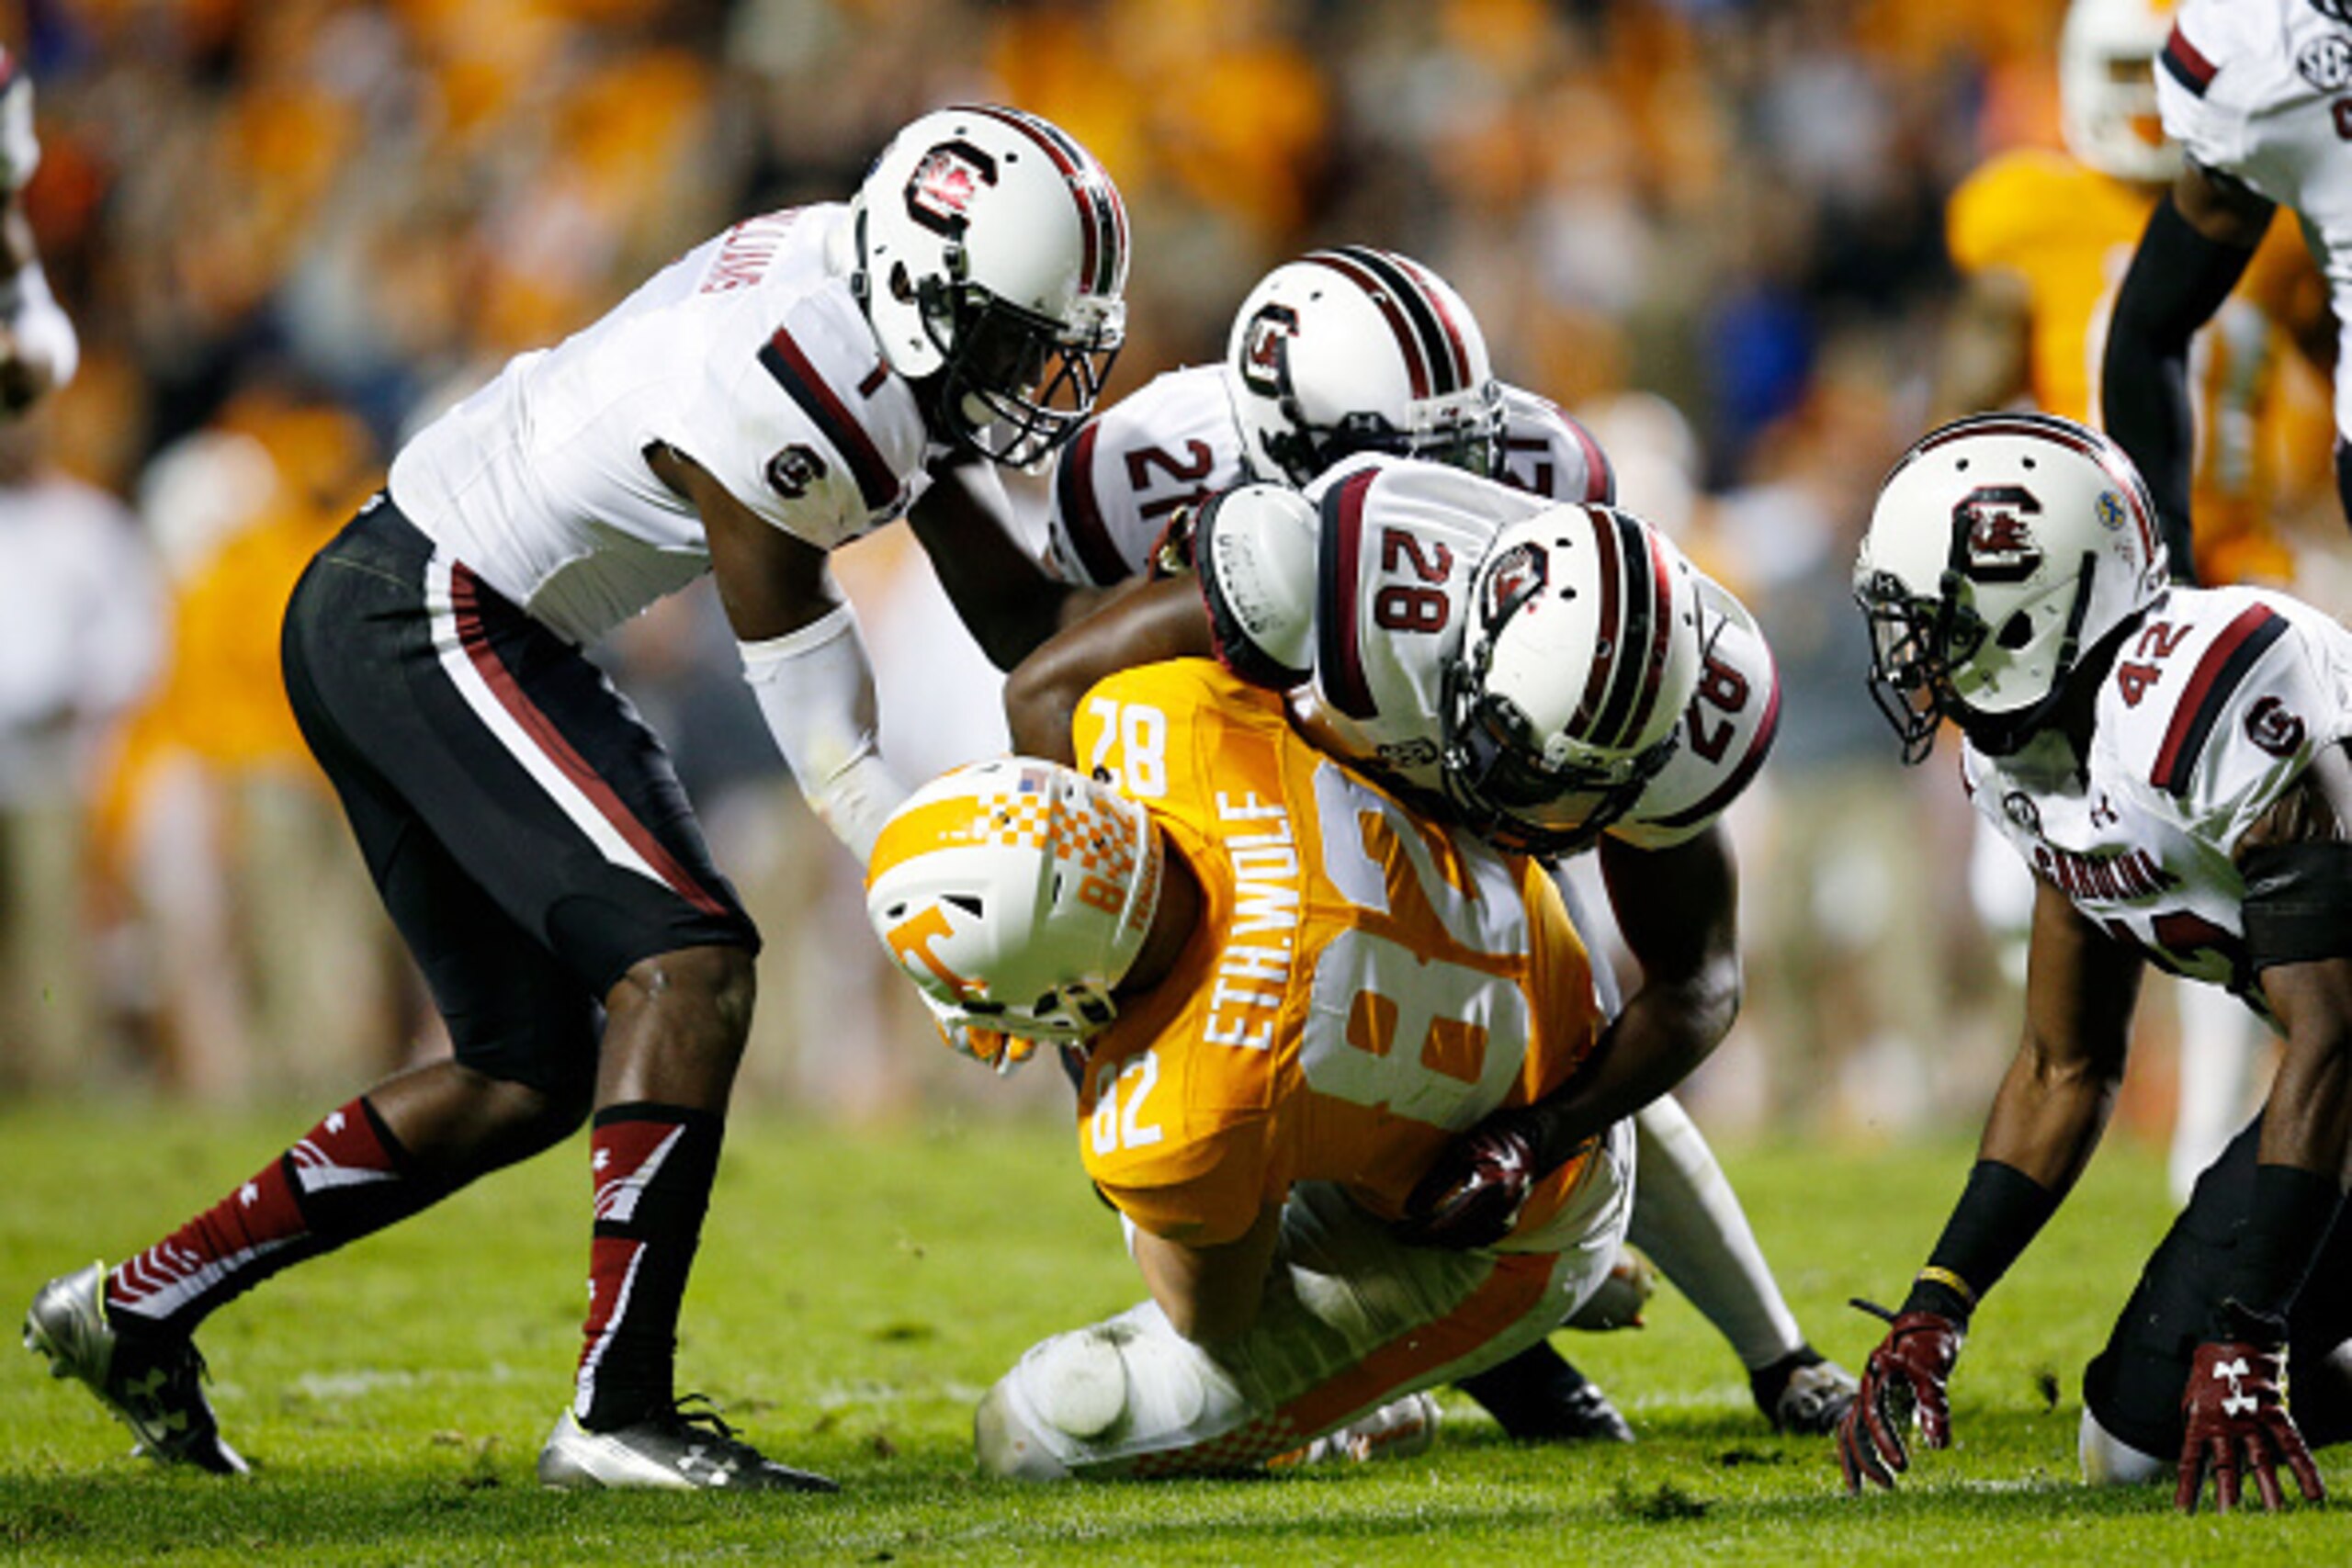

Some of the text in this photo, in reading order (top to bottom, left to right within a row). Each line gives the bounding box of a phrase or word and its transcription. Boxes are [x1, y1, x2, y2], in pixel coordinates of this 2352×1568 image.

[1124, 439, 1215, 522] 21
[1374, 527, 1454, 635] 28
[2118, 621, 2194, 708] 42
[1204, 792, 1301, 1050] ETH.WOLF
[1297, 757, 1532, 1132] 82
[1091, 1049, 1164, 1156] 82
